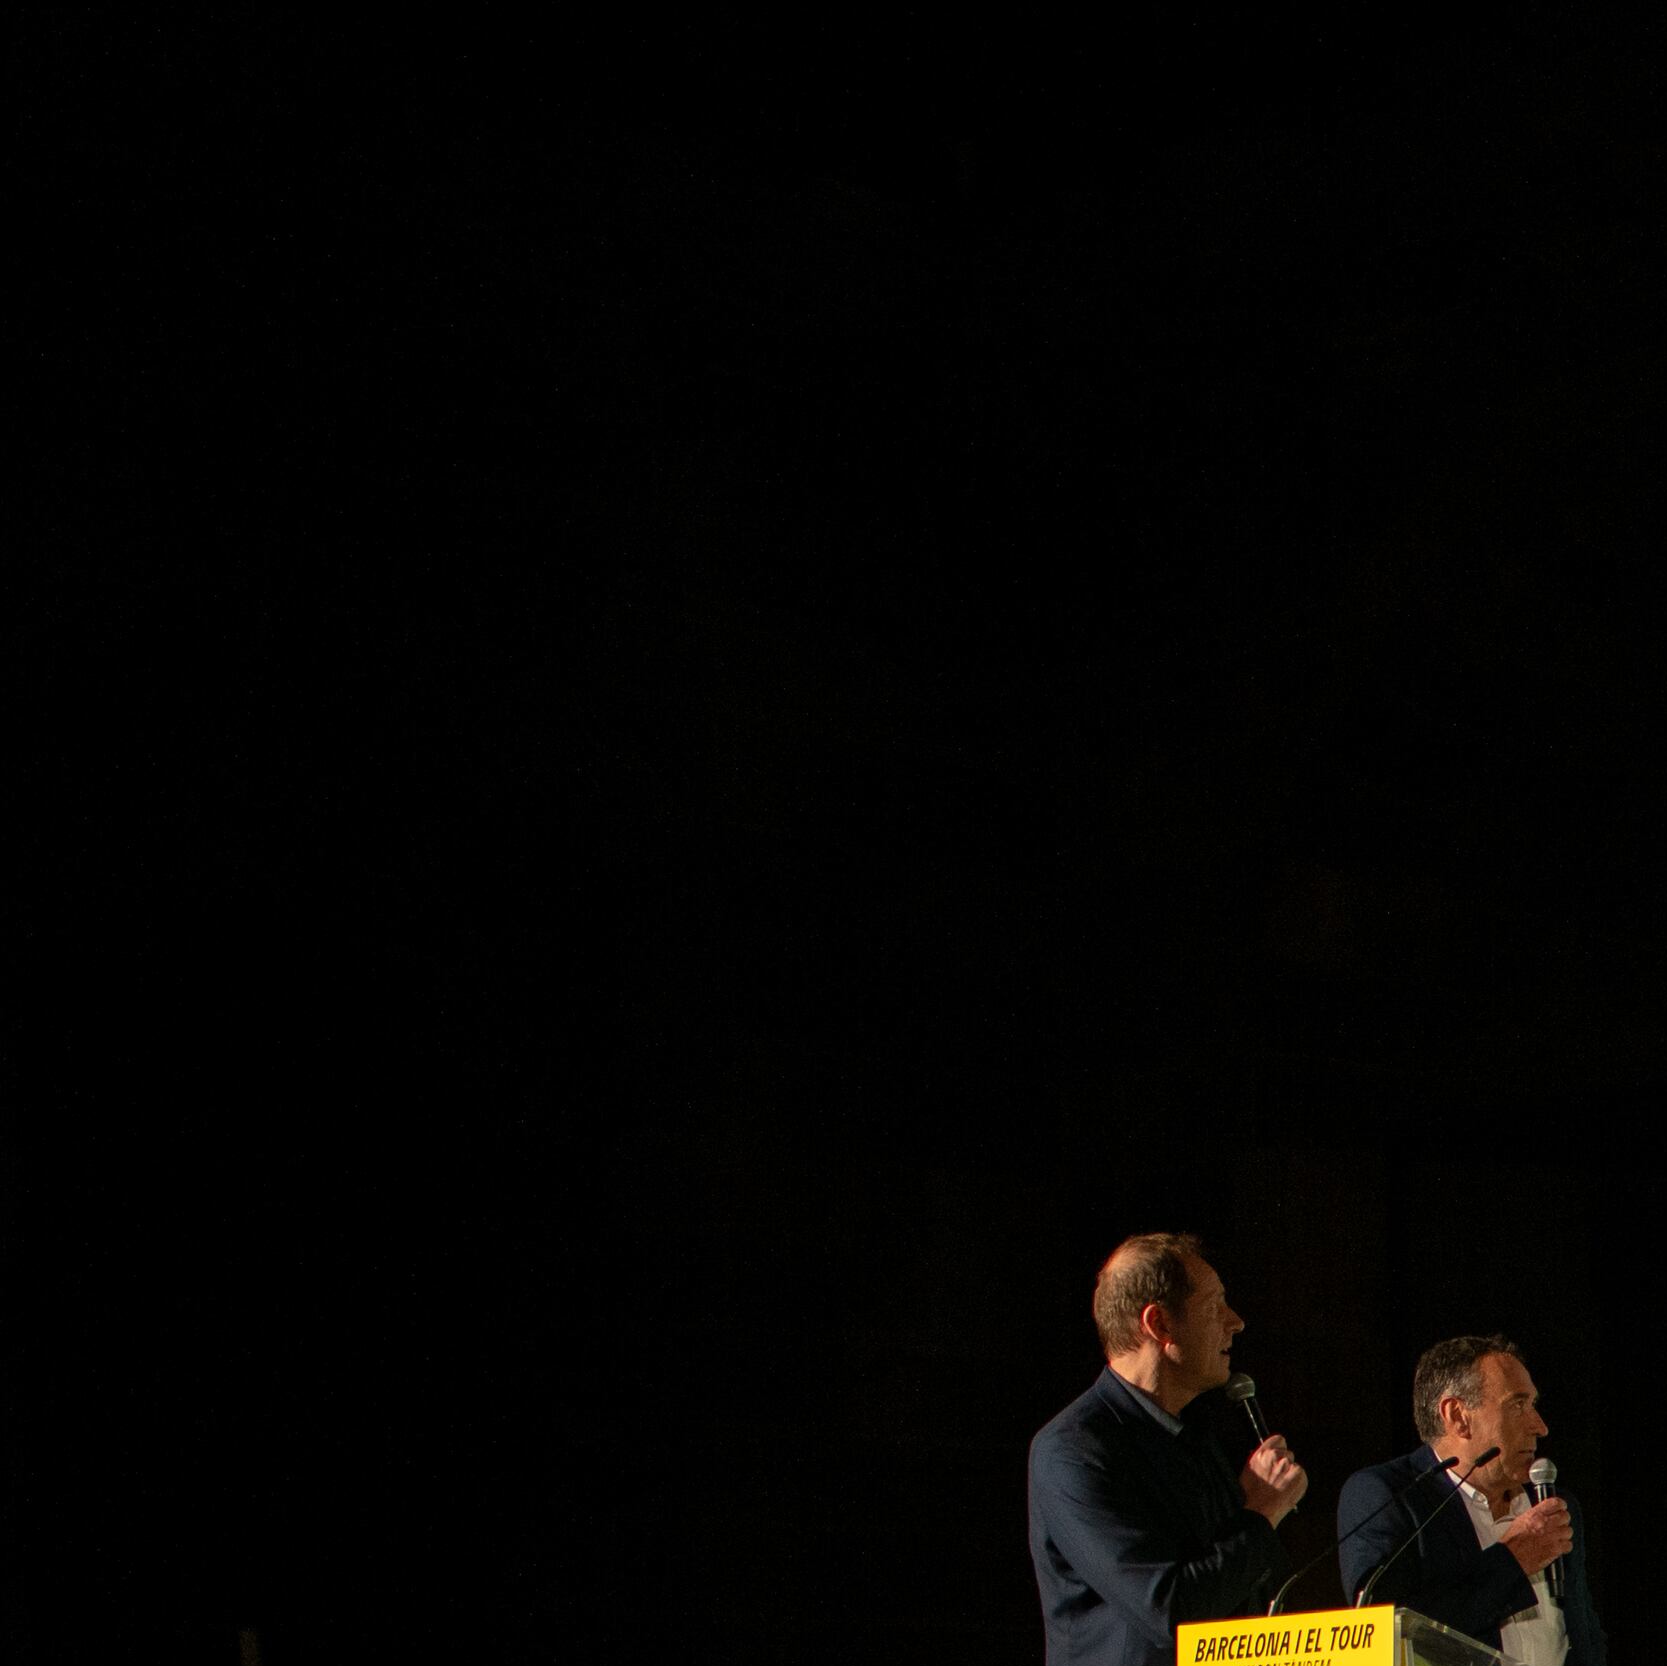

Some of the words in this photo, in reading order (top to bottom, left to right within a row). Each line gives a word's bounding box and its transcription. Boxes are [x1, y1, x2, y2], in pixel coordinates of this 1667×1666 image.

[1194, 1630, 1291, 1663] BARCELONA
[1305, 1628, 1322, 1653] EL
[1330, 1623, 1375, 1652] TOUR
